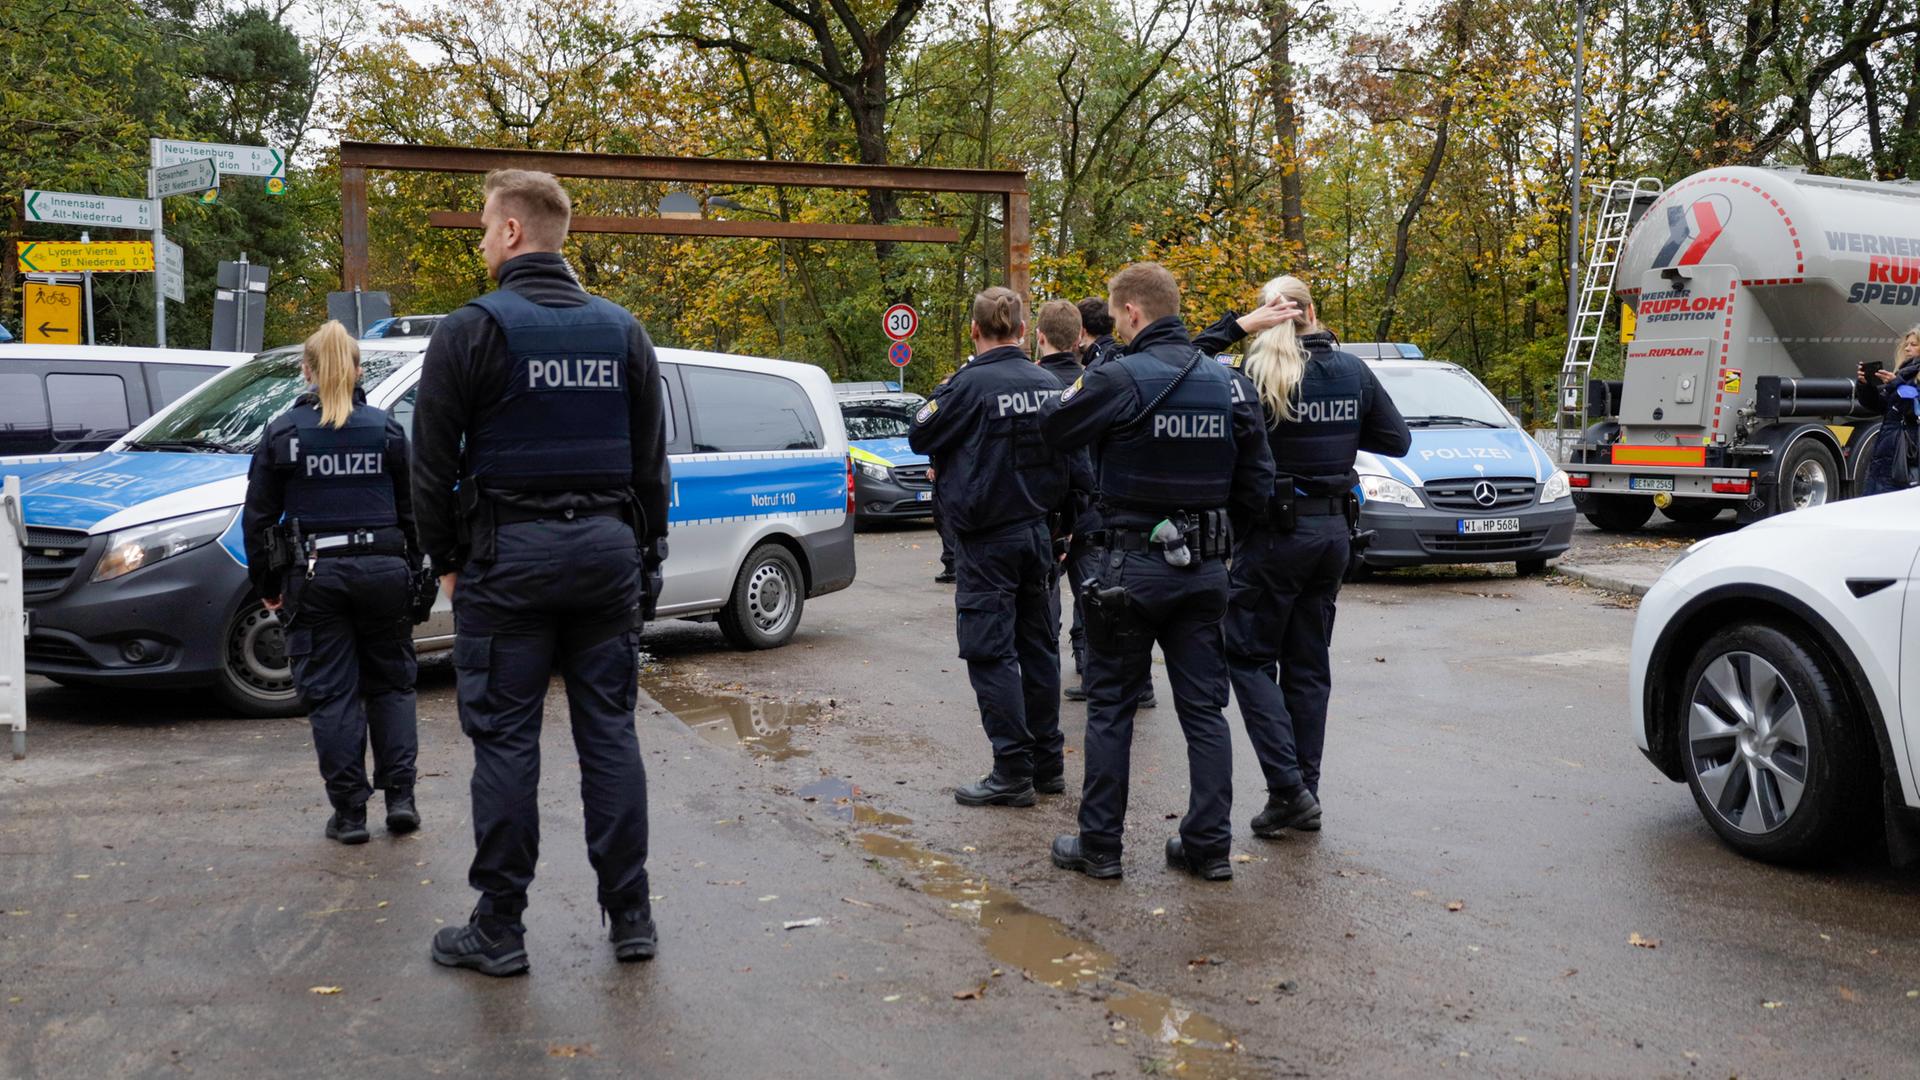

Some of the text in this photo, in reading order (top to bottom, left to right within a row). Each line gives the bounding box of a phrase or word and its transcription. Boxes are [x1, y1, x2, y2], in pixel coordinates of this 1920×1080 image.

[164, 144, 234, 159] Neu-Isenburg
[51, 197, 105, 210] Innenstadt
[52, 209, 123, 224] Alt-Niederrad
[1824, 230, 1920, 257] WERNER
[48, 247, 82, 257] Lyoner
[85, 247, 118, 256] Viertel
[76, 257, 126, 267] Niederrad
[132, 257, 147, 266] 0.7
[1641, 289, 1691, 301] WERNER
[1640, 296, 1728, 315] RUPLOH
[890, 314, 910, 330] 30
[1647, 311, 1717, 323] SPEDITION
[528, 359, 619, 388] POLIZEI
[1298, 399, 1358, 423] POLIZEI
[1153, 414, 1225, 438] POLIZEI
[1420, 446, 1513, 461] POLIZEI
[306, 452, 383, 477] POLIZEI
[752, 492, 797, 507] Notruf 110
[1464, 518, 1519, 532] WI HP 5684
